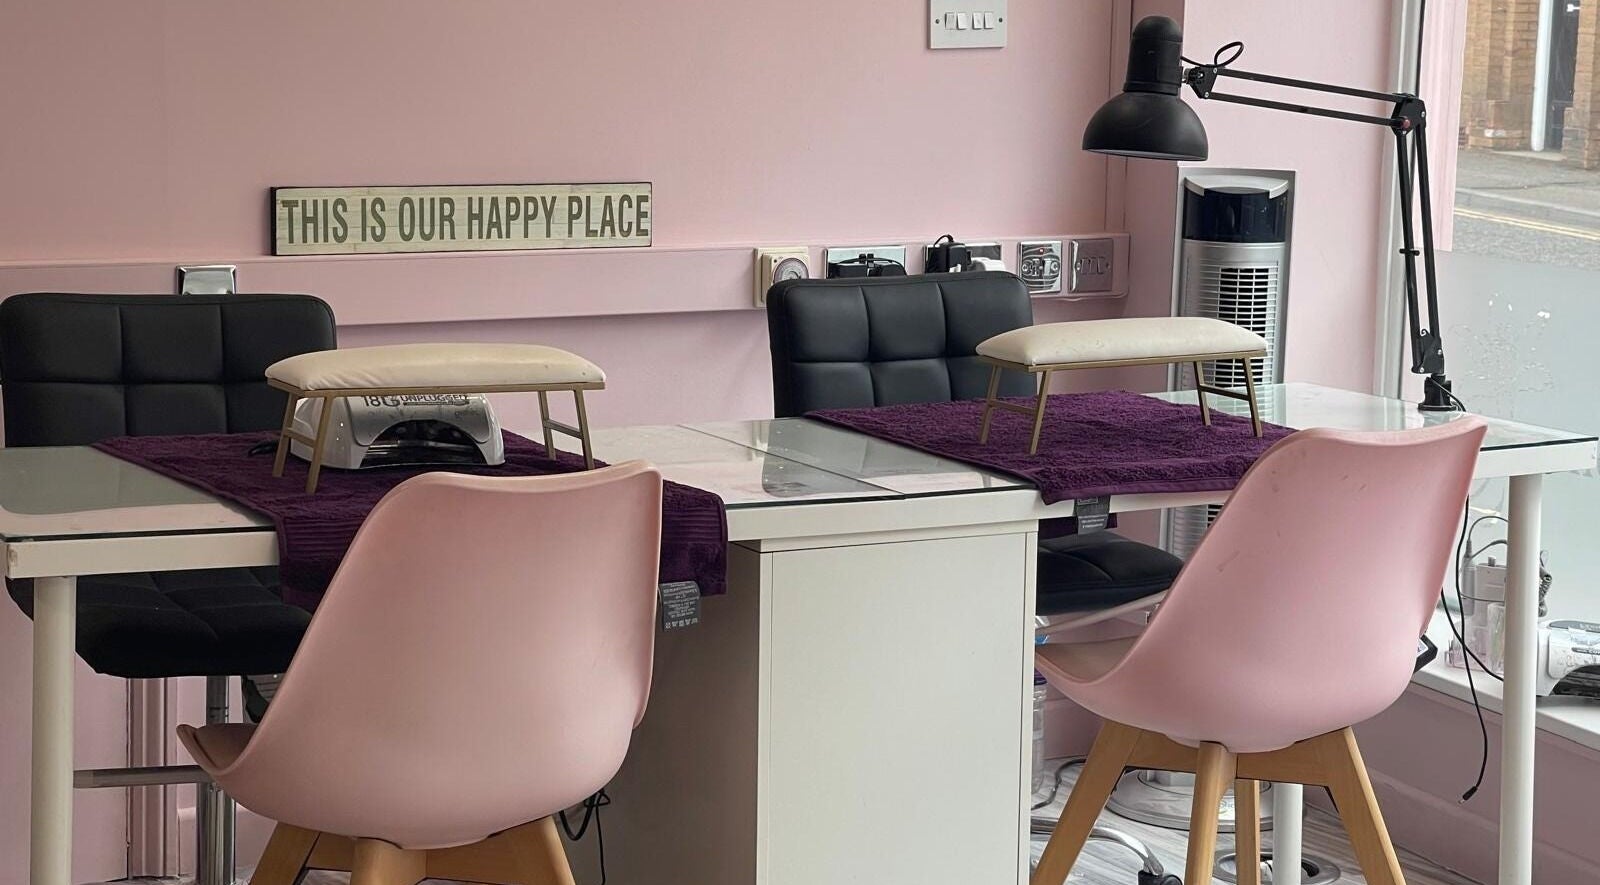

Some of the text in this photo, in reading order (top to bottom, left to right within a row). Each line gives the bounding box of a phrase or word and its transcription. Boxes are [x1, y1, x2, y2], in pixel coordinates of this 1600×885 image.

[281, 194, 649, 244] THIS IS OUR HAPPY PLACE
